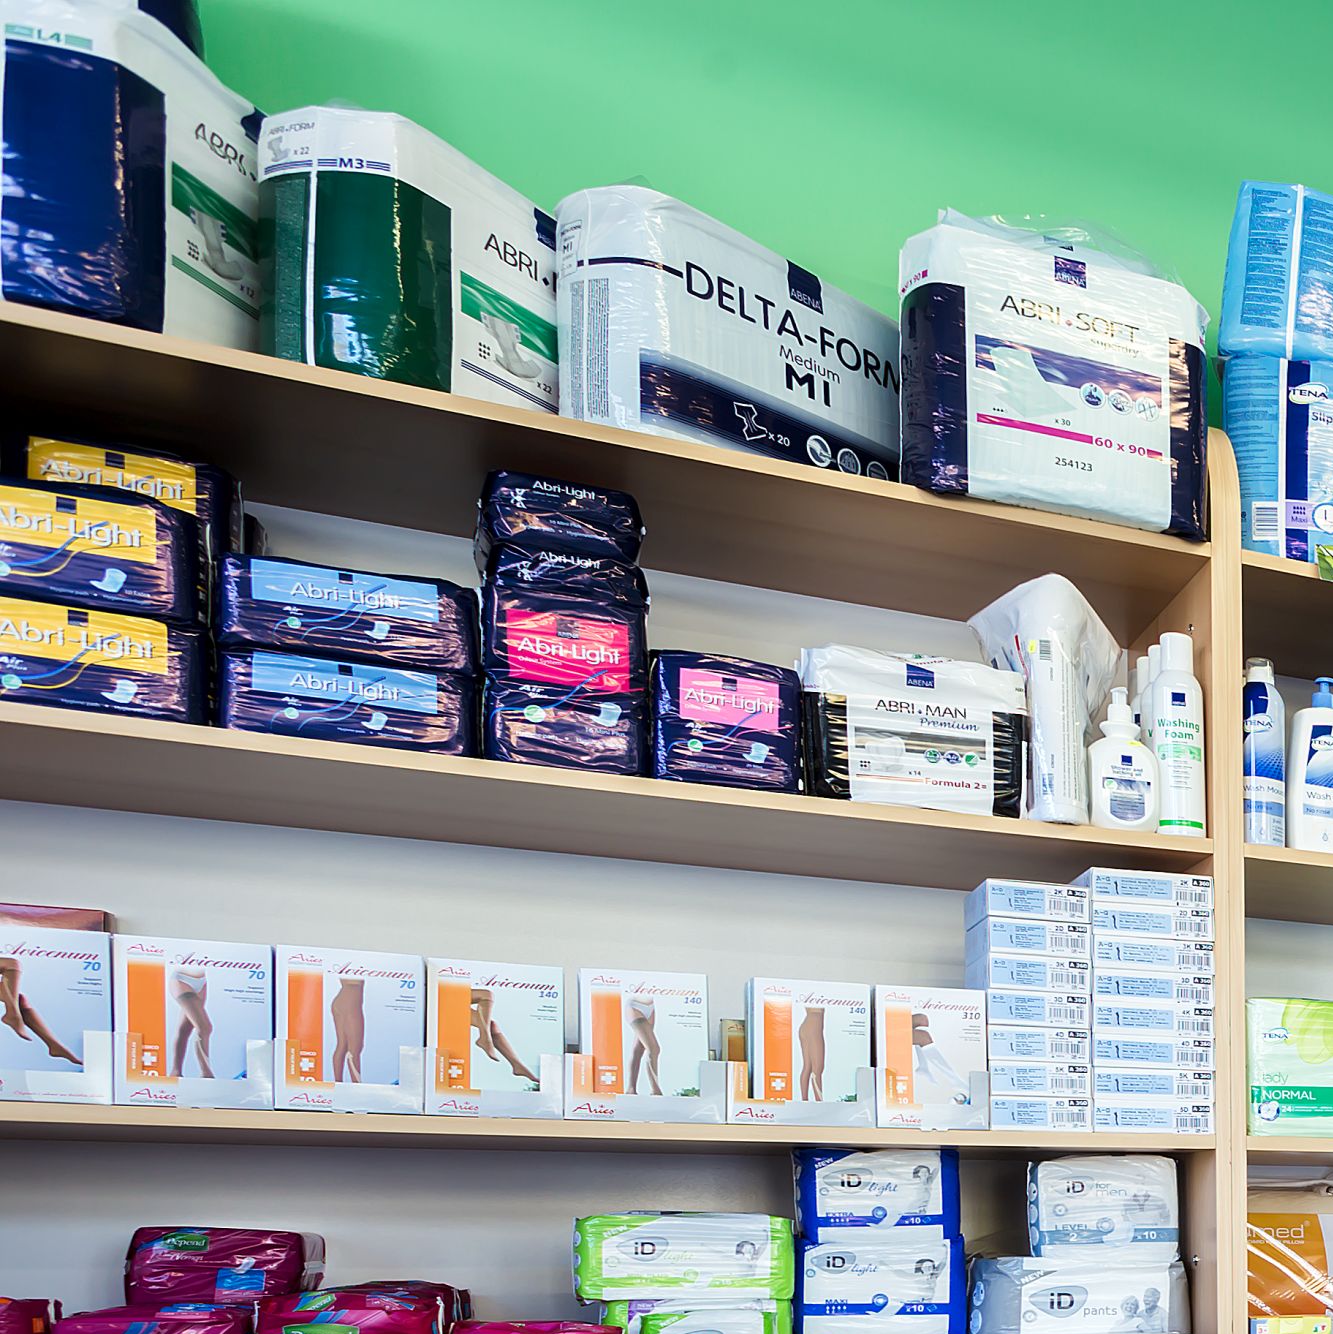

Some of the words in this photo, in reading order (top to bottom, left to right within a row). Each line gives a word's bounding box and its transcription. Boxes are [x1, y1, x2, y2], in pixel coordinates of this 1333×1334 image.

[339, 158, 364, 169] M3
[484, 233, 538, 282] ABRI
[791, 288, 821, 311] ABENA
[1000, 295, 1060, 326] ABRI
[1076, 312, 1140, 343] SOFT
[779, 345, 840, 384] Medium
[1289, 387, 1329, 399] TENA
[1061, 418, 1071, 427] 30
[1311, 411, 1333, 425] Slip
[777, 434, 790, 447] 20
[1095, 437, 1112, 449] 60
[1129, 444, 1146, 457] 90
[1055, 457, 1092, 472] 254123
[40, 459, 185, 500] Abri-Light
[532, 480, 596, 501] Abri-Light
[539, 551, 601, 570] Abri-Light
[290, 582, 401, 609] Abri-Light
[0, 619, 155, 659] Abri-Light
[518, 637, 621, 666] Abri-Light
[289, 673, 401, 701] Abri-Light
[906, 678, 934, 688] ABENA
[685, 687, 776, 714] Abri-Light
[875, 699, 915, 715] ABRI
[925, 703, 967, 720] MAN
[919, 717, 980, 732] Premium
[1157, 718, 1200, 733] Washing
[1164, 729, 1194, 741] Foam
[925, 777, 971, 789] Formula
[1307, 791, 1331, 802] Wash
[128, 943, 166, 955] Aries
[170, 952, 263, 970] Avicenum
[289, 953, 323, 964] Aries
[82, 961, 101, 972] 70
[328, 961, 414, 980] Avicenum
[438, 966, 471, 977] Aries
[248, 970, 265, 980] 70
[399, 980, 416, 989] 70
[475, 974, 556, 992] Avicenum
[538, 991, 558, 999] 140
[795, 991, 864, 1008] Avicenum
[849, 1007, 866, 1015] 140
[962, 1012, 980, 1020] 310
[1263, 1032, 1289, 1040] TENA
[130, 1088, 176, 1101] Aries
[289, 1093, 332, 1105] Aries
[1262, 1089, 1316, 1100] NORMAL
[438, 1100, 479, 1112] Aries
[572, 1103, 616, 1115] Aries
[736, 1107, 775, 1120] Aries
[890, 1114, 922, 1124] Aries
[840, 1173, 862, 1188] iD
[1066, 1181, 1085, 1194] iD
[1137, 1231, 1157, 1240] x10
[166, 1237, 206, 1248] Depend
[634, 1241, 656, 1256] iD
[825, 1256, 846, 1270] iD
[1049, 1292, 1075, 1310] iD
[1083, 1306, 1118, 1317] pants
